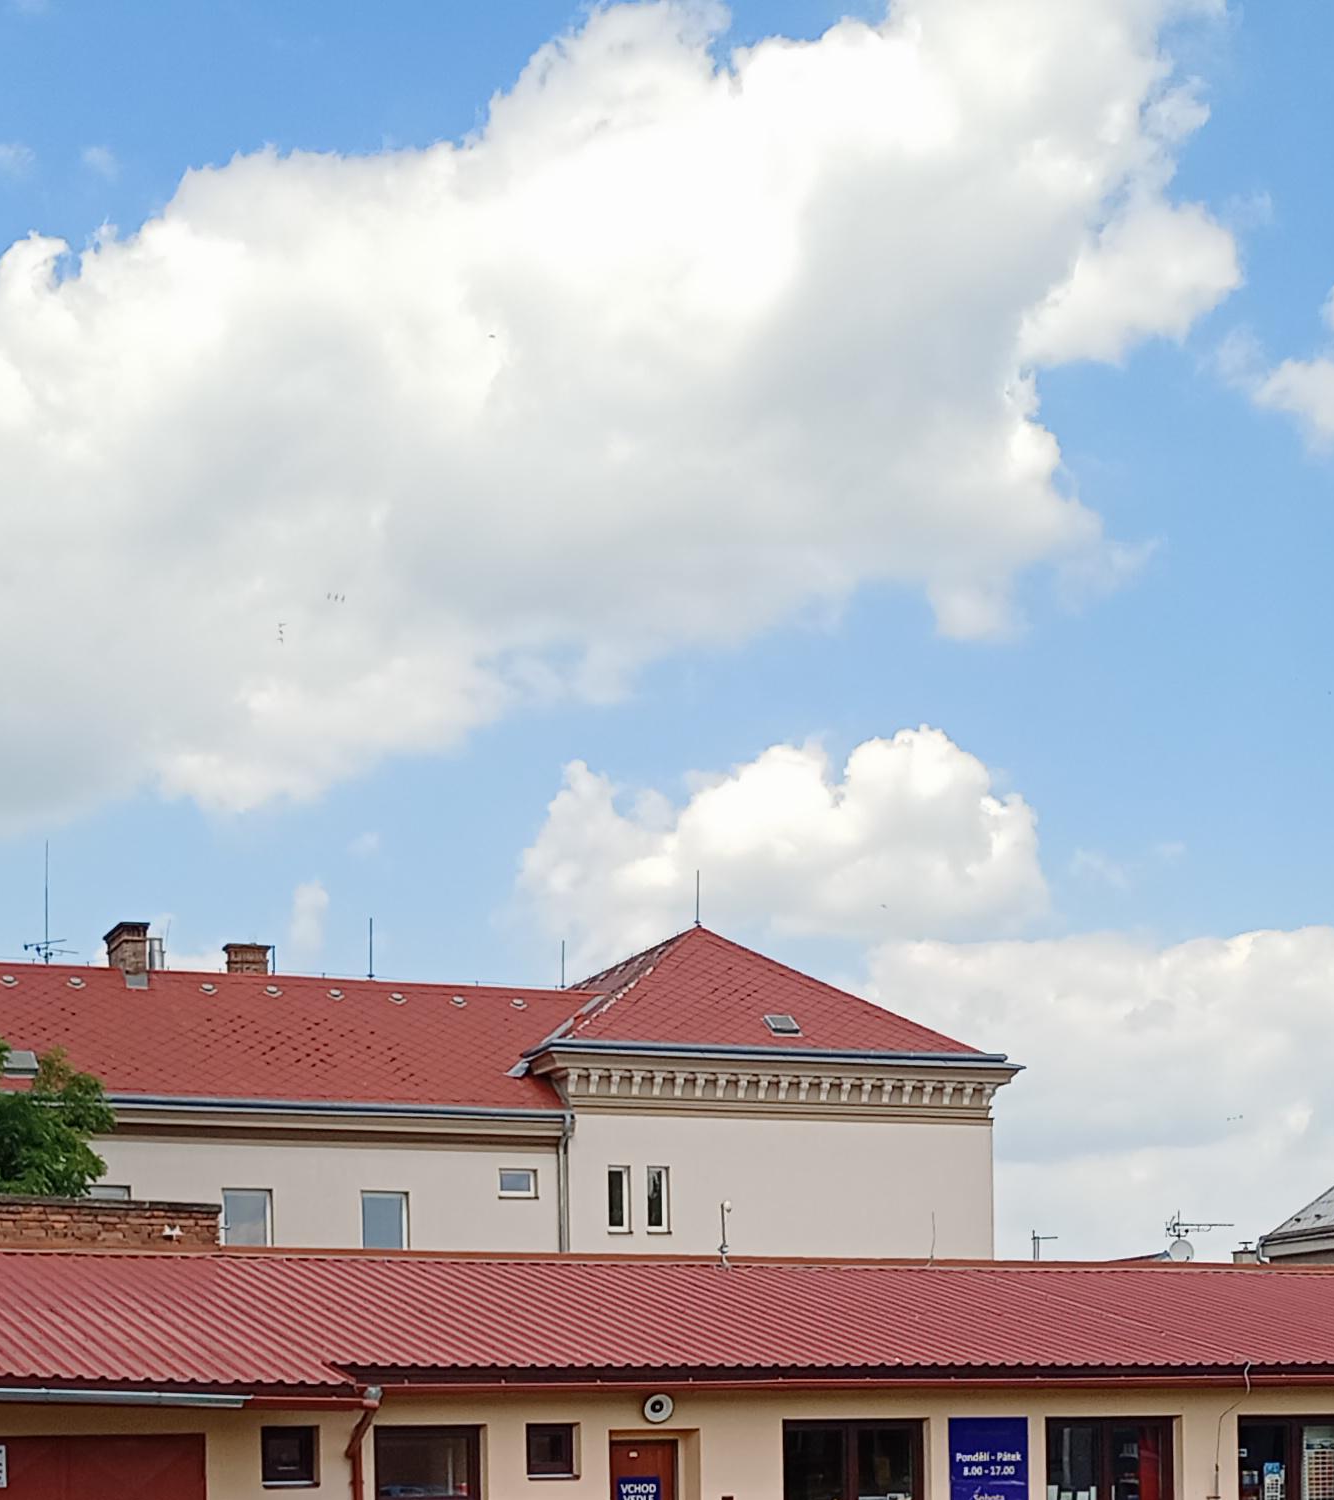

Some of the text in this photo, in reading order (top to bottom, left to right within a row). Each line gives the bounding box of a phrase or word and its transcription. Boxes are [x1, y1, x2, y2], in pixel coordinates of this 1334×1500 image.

[955, 1451, 990, 1463] Pondělí
[996, 1451, 1023, 1462] Pátek
[962, 1465, 983, 1477] 8.00
[990, 1465, 1016, 1476] 17.00
[620, 1483, 657, 1494] VCHOD
